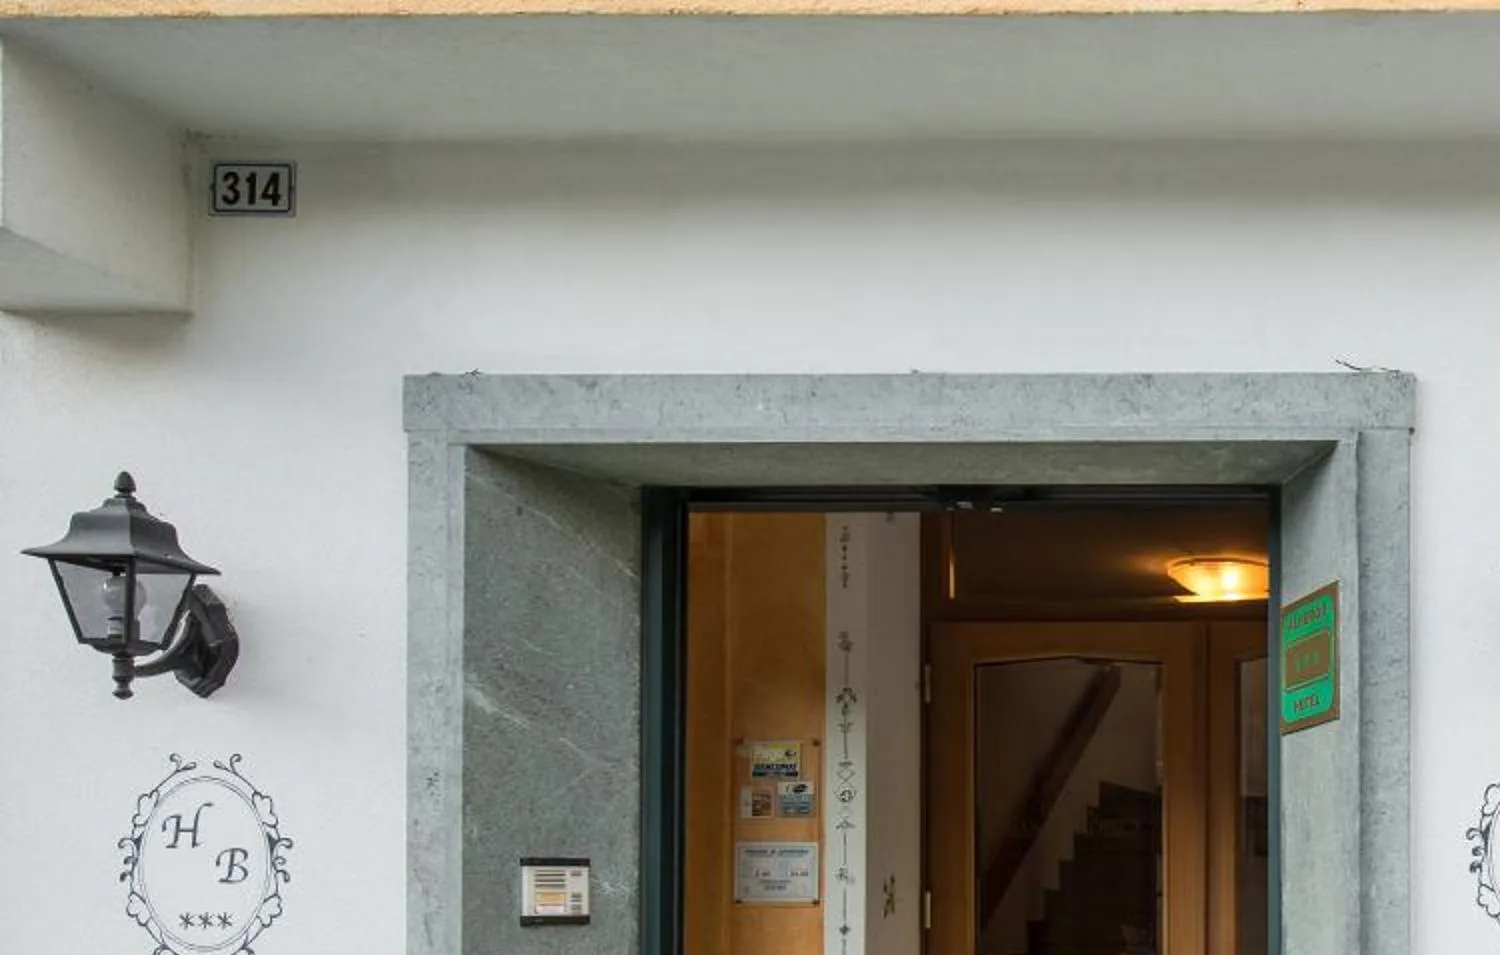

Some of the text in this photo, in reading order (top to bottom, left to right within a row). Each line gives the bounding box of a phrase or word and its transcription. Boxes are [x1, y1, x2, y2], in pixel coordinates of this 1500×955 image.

[222, 171, 281, 206] 314
[161, 802, 214, 849] H
[215, 847, 249, 884] B
